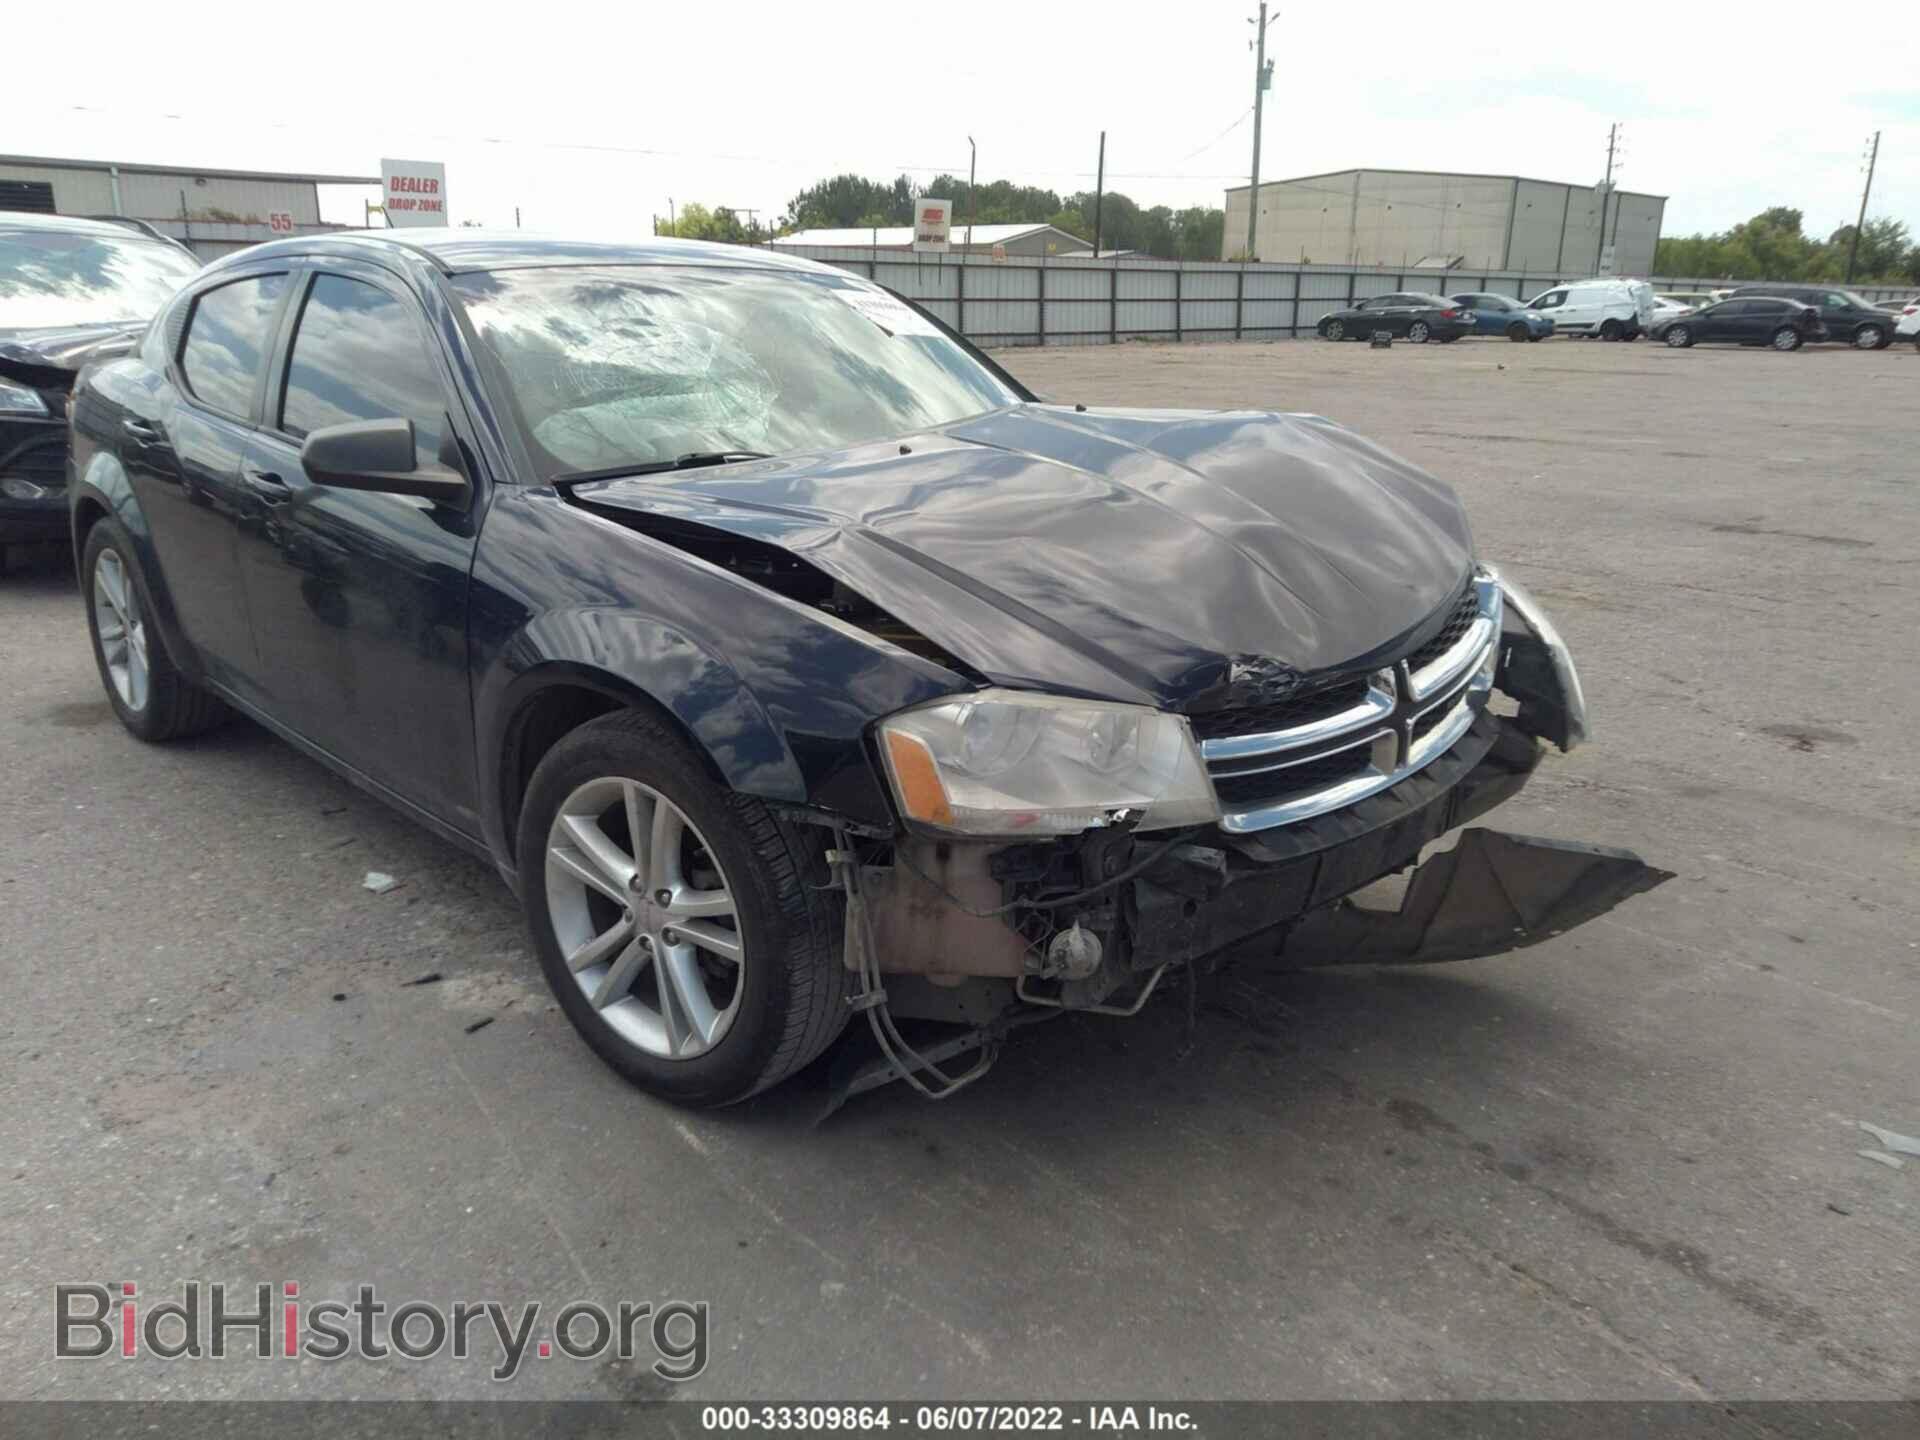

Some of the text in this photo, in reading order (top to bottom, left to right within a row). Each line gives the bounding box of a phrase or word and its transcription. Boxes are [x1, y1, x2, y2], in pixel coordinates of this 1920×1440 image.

[391, 176, 439, 193] DEALER
[388, 198, 442, 212] DROP ZONE
[271, 214, 292, 231] 55
